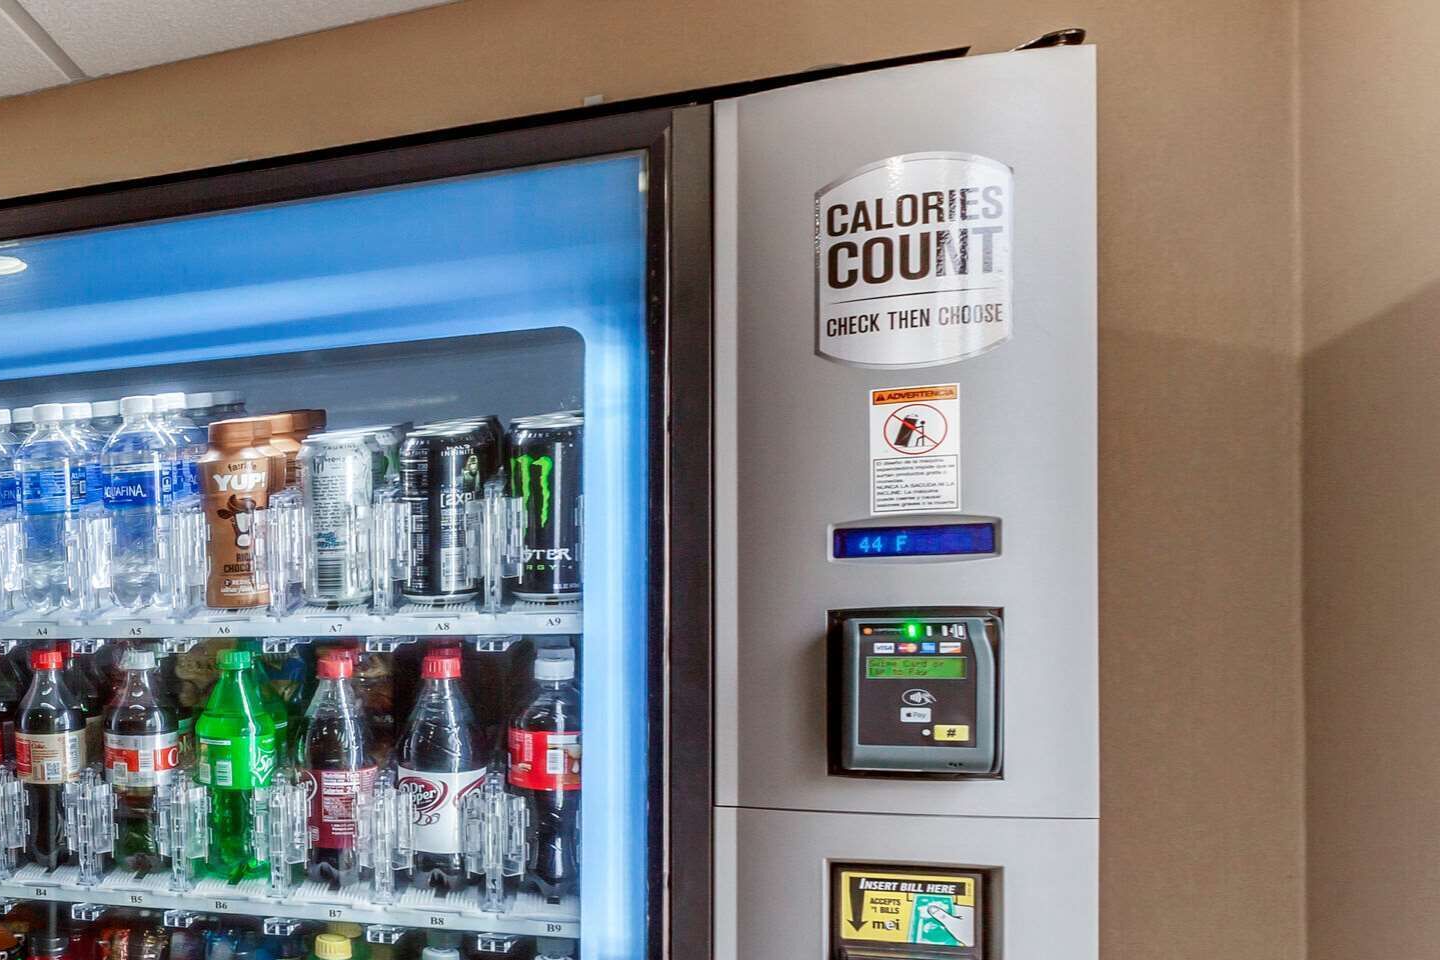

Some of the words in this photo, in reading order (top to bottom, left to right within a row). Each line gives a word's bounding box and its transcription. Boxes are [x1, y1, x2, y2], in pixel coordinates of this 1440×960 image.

[827, 185, 1003, 237] CALORIES
[827, 226, 1003, 289] COUNT
[826, 310, 881, 338] CHECK
[887, 308, 930, 331] THEN
[937, 303, 1004, 326] CHOOSE
[886, 389, 955, 401] ADVERTENCIA
[859, 535, 883, 553] 44
[895, 533, 908, 552] F
[36, 627, 48, 636] A4
[129, 627, 143, 636] A5
[217, 625, 231, 635] A6
[328, 623, 343, 633] A7
[435, 623, 450, 632] A8
[546, 617, 562, 627] A9
[859, 878, 900, 891] INSERT
[900, 882, 924, 892] BILL
[926, 883, 957, 895] HERE
[35, 888, 48, 897] B4
[215, 900, 228, 910] B6
[329, 909, 342, 918] B7
[429, 916, 445, 926] B8
[545, 923, 562, 933] B9
[869, 897, 901, 906] ACCEPTS
[872, 919, 900, 930] mei
